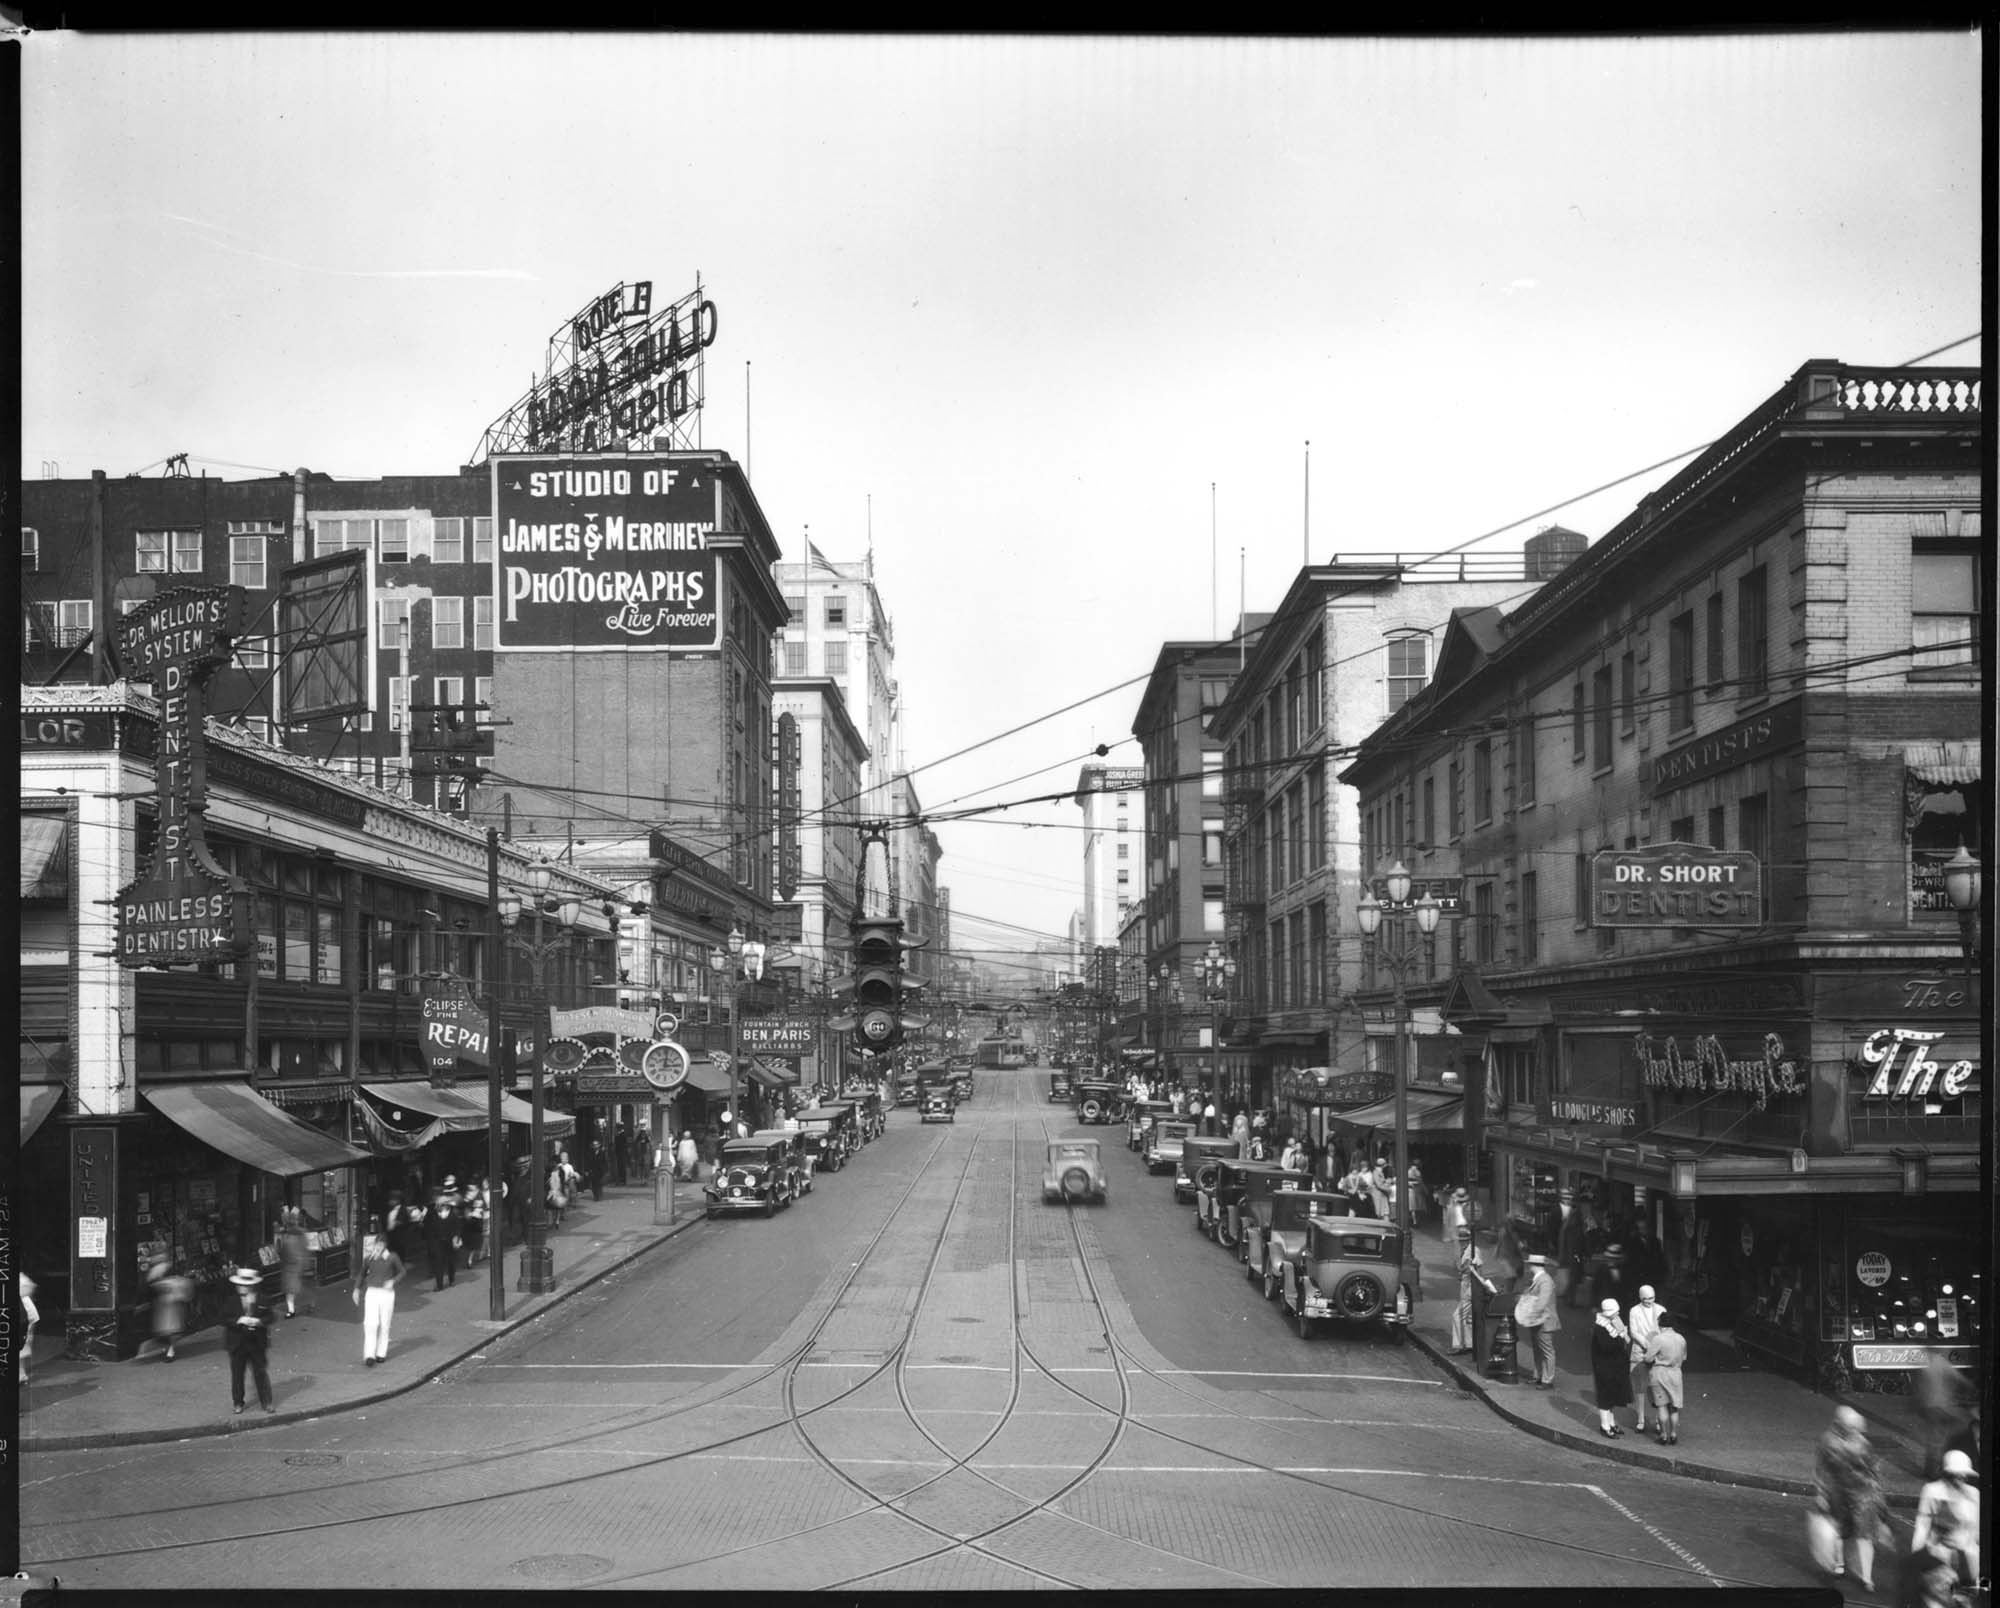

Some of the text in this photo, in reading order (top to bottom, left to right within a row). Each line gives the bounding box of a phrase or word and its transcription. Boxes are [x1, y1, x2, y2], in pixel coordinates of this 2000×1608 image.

[530, 470, 679, 497] STUDIO OF
[502, 513, 713, 560] JAMES & MERRIHEW
[505, 566, 704, 622] PHOTOGRAPHS
[129, 599, 220, 649] DR. MELLOR'S
[606, 603, 716, 635] Live Forever
[144, 628, 203, 664] SYSTEM
[1655, 717, 1773, 783] DENTISTS
[165, 666, 181, 882] DENTIST
[1615, 864, 1739, 883] DR. SHORT
[126, 894, 224, 924] PAINLESS
[1600, 890, 1753, 917] DENTIST
[126, 927, 222, 954] DENTISTRY
[423, 998, 464, 1018] ECLIPSE
[1903, 979, 1966, 1009] The
[743, 1029, 812, 1041] BEN PARIS
[870, 1022, 886, 1032] GO
[432, 1056, 453, 1066] 104
[1704, 1033, 1767, 1111] Drug
[1860, 1028, 1972, 1099] The
[1324, 1090, 1361, 1100] MEAT
[1565, 1102, 1602, 1123] DOUGLAS
[1604, 1106, 1636, 1126] SHOES
[1862, 1253, 1886, 1265] TODAY
